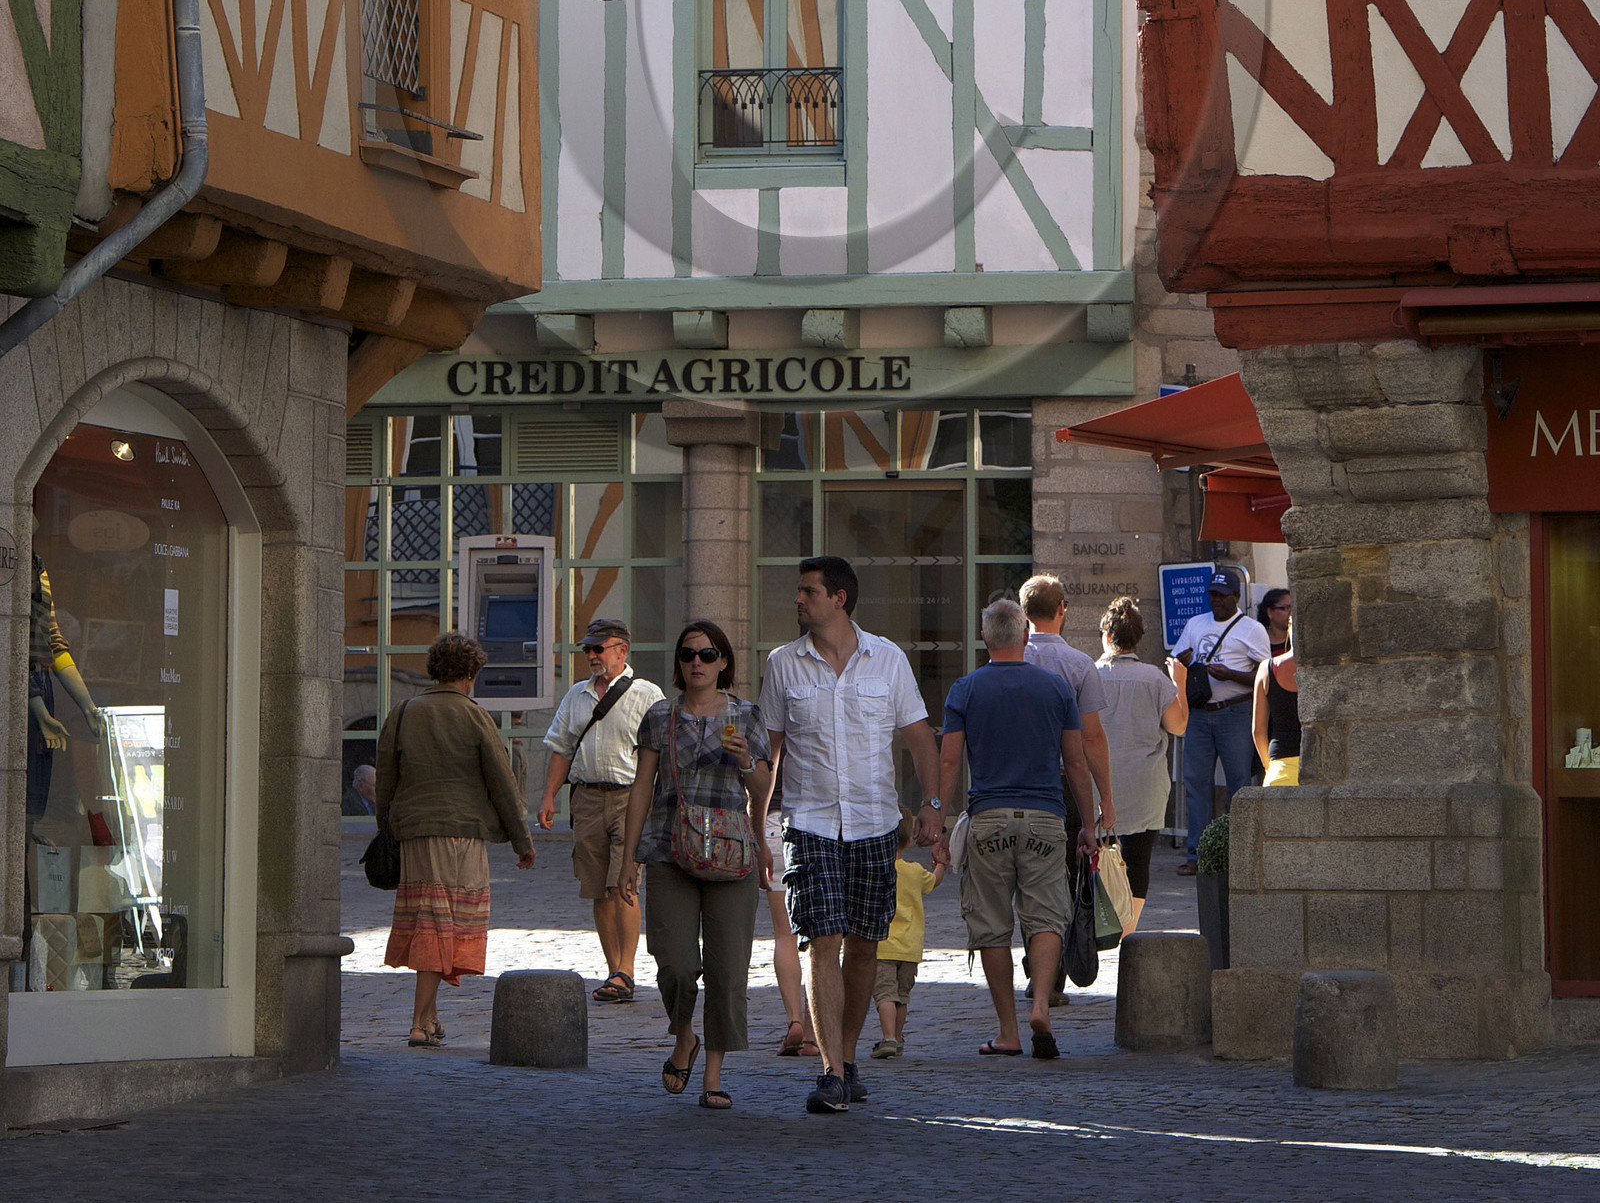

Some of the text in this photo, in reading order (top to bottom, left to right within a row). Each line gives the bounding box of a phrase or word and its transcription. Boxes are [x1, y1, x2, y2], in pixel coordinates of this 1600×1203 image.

[447, 355, 913, 397] CREDIT AGRICOLE
[1073, 543, 1126, 556] BANQUE
[1092, 563, 1104, 575] ET
[1171, 576, 1204, 586] LIVRAISONS
[1064, 582, 1139, 595] ASSURANCES
[1174, 597, 1203, 605] RIVERAINS
[976, 835, 1055, 857] G-STAR RAW
